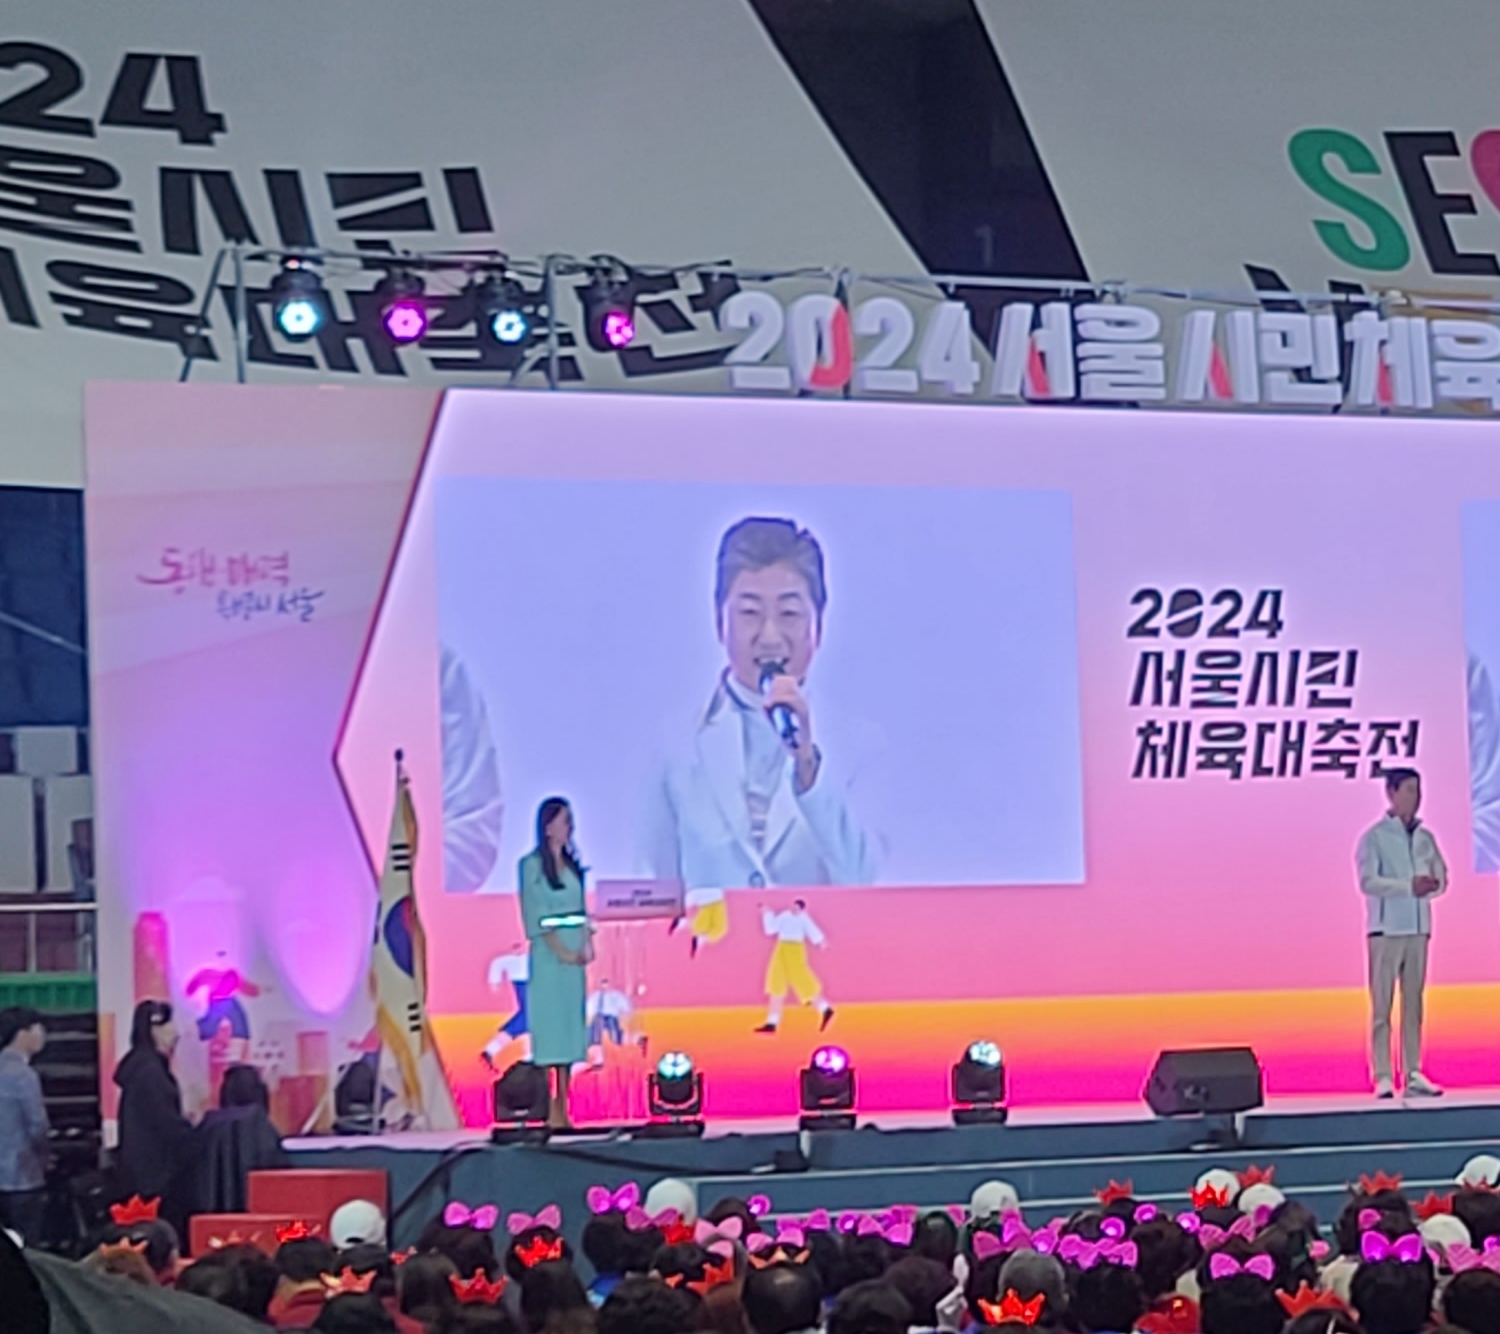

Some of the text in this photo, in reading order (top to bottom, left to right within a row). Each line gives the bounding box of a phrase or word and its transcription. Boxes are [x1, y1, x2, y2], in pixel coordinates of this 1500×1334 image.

[1126, 587, 1284, 640] 2024
[1129, 649, 1358, 709] 서울시민
[1131, 718, 1420, 781] 체육대축전
